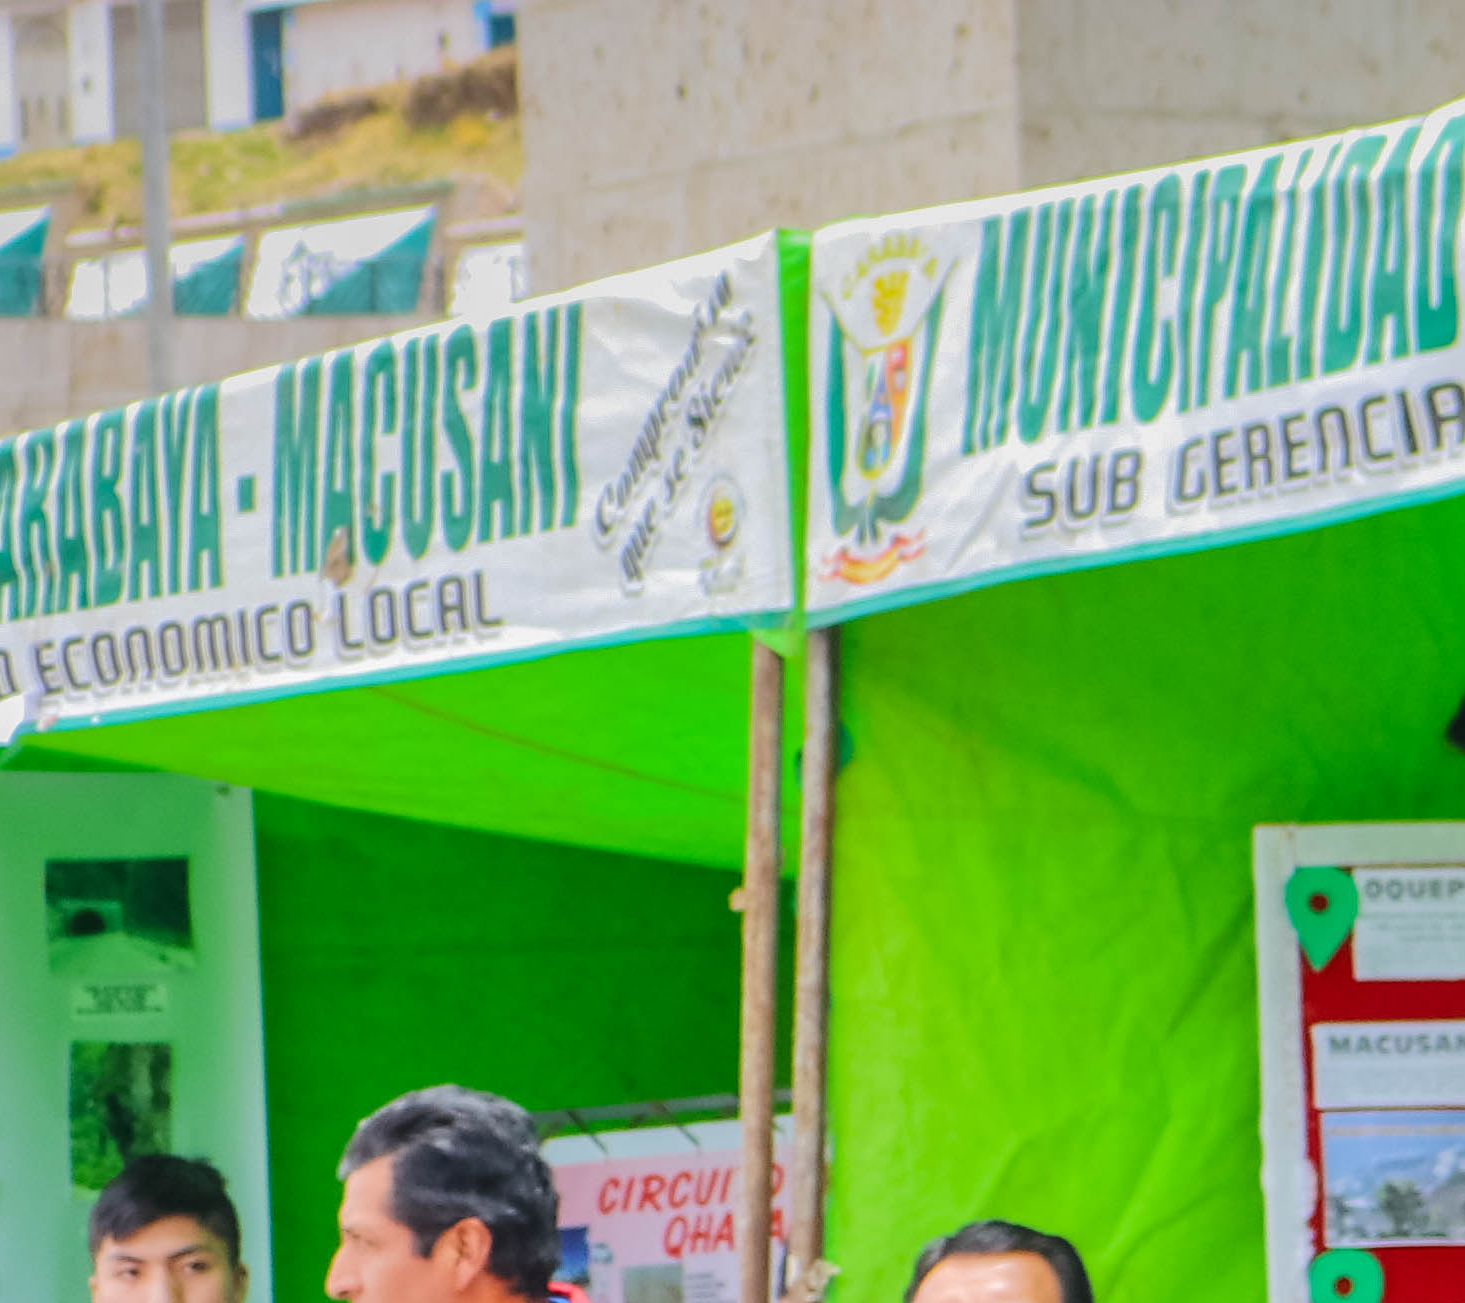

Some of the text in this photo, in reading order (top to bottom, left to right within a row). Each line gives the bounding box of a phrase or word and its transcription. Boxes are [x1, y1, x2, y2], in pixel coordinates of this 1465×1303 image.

[271, 300, 584, 578] MACUSANI
[1024, 450, 1144, 530] SUB
[35, 598, 316, 696] ECONOMICO
[335, 570, 503, 649] LOCAL
[598, 1160, 785, 1216] CIRCUIO
